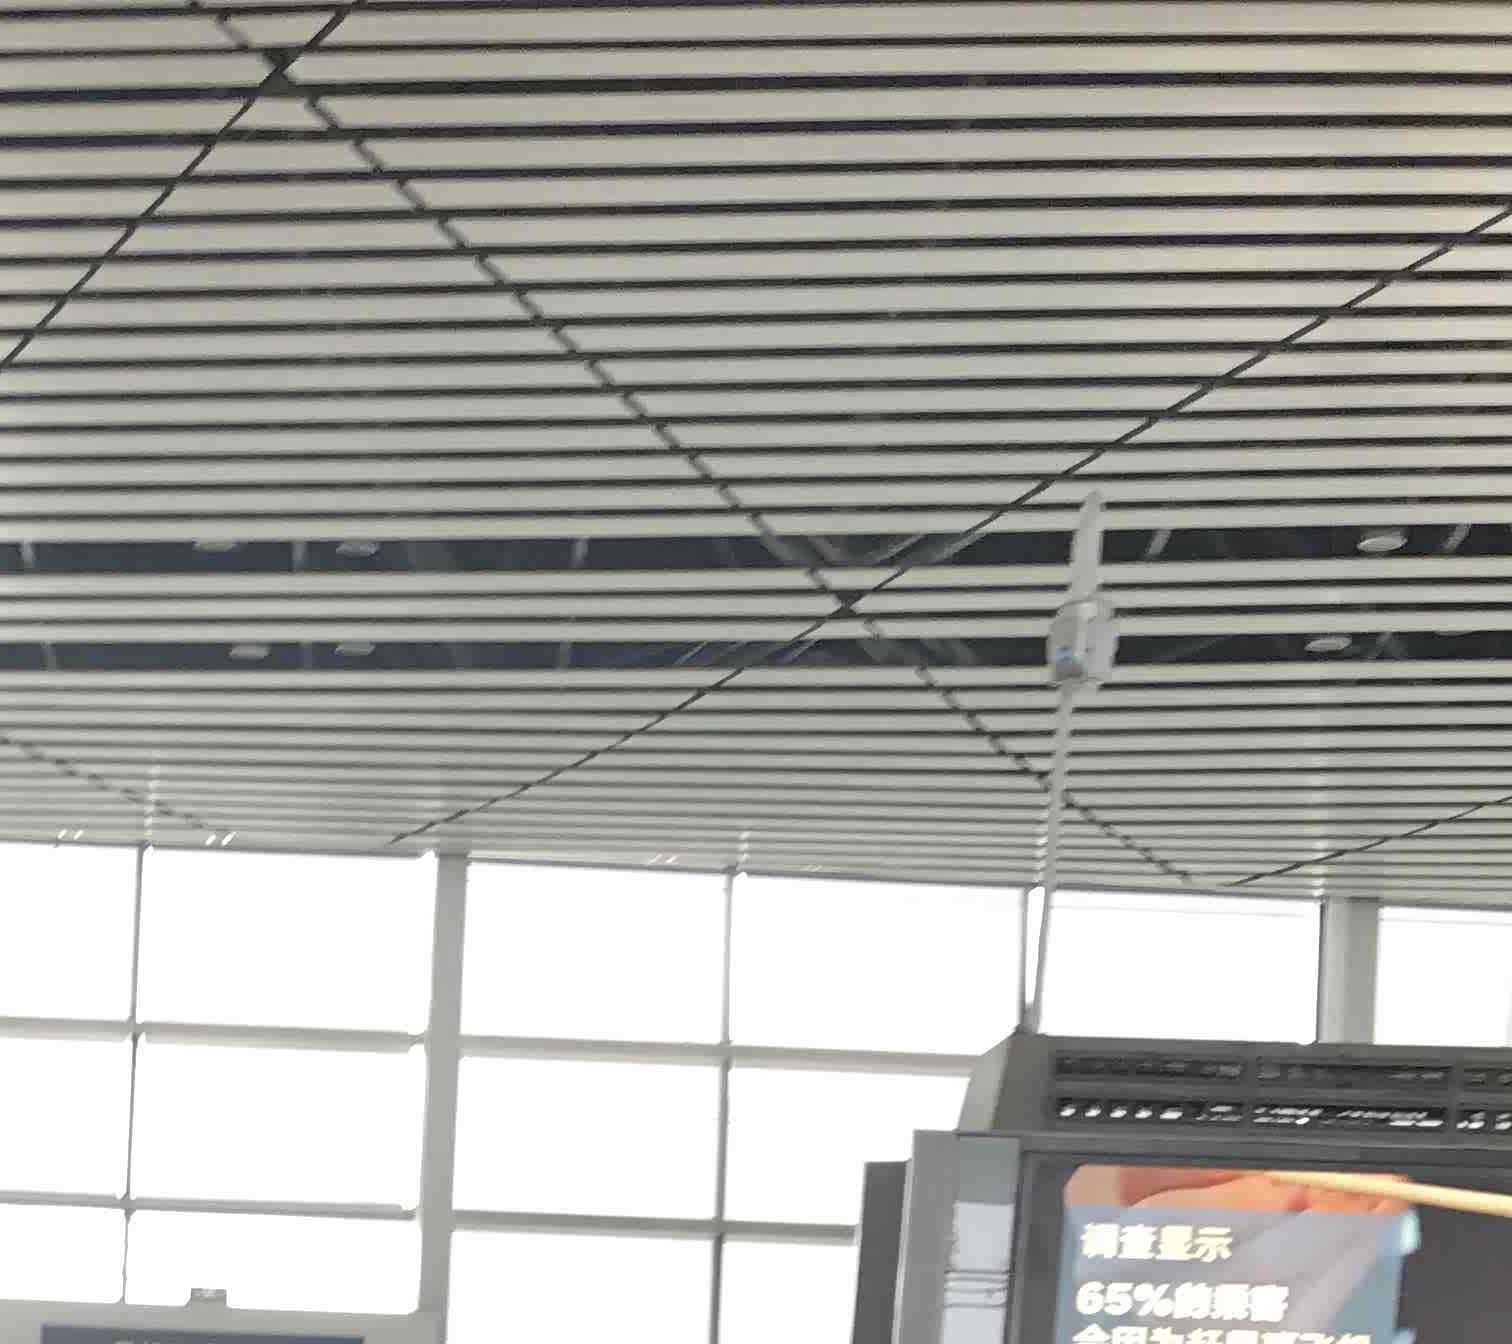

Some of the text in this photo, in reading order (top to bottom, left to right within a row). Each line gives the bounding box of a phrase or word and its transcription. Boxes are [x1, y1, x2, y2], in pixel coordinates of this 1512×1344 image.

[1080, 1222, 1233, 1263] 调查显示
[1075, 1282, 1289, 1323] 65%的乘客
